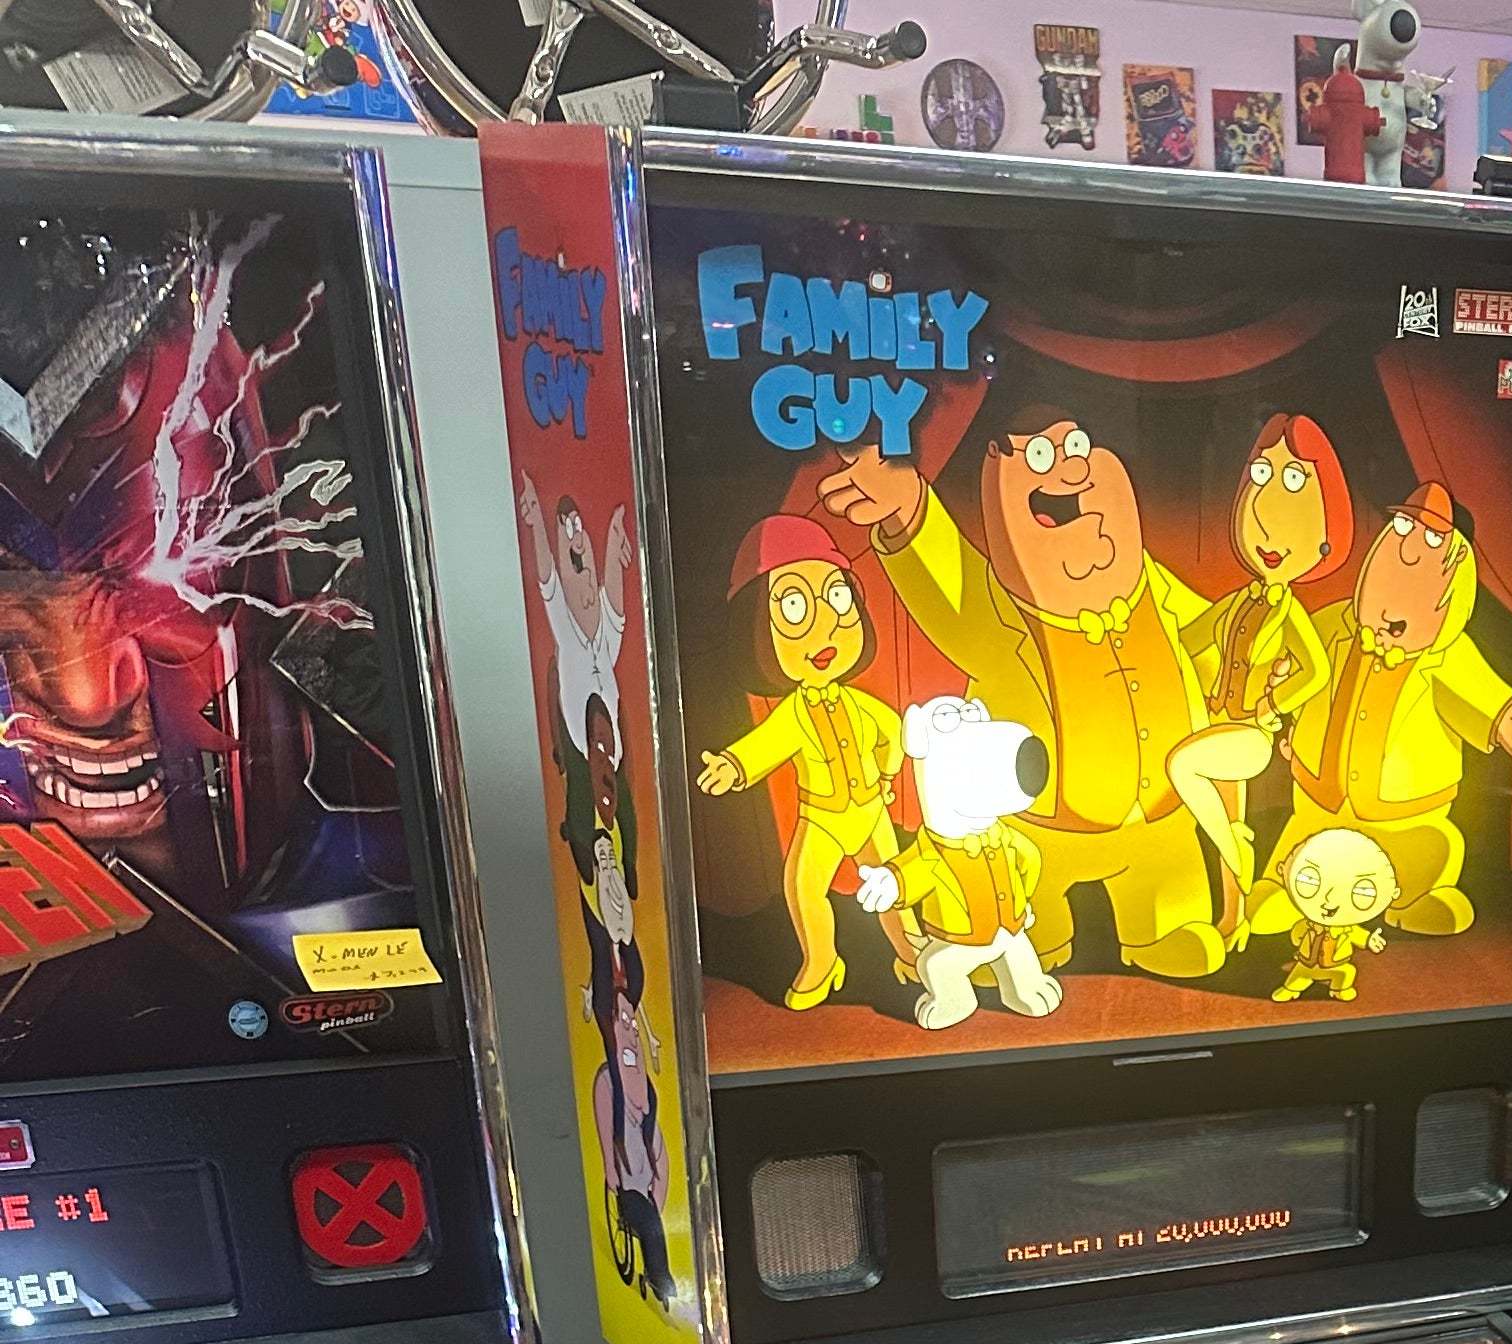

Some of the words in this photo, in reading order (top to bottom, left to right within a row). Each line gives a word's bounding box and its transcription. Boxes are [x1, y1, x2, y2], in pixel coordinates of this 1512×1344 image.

[1036, 25, 1099, 53] GUNDAM
[496, 226, 606, 356] FAMILY
[698, 245, 989, 371] FAMILY
[1404, 315, 1431, 328] FOX
[522, 348, 590, 439] GUY
[751, 364, 928, 458] GUY
[291, 995, 379, 1024] Stern
[320, 1011, 376, 1031] pinball
[56, 1187, 109, 1223] #1
